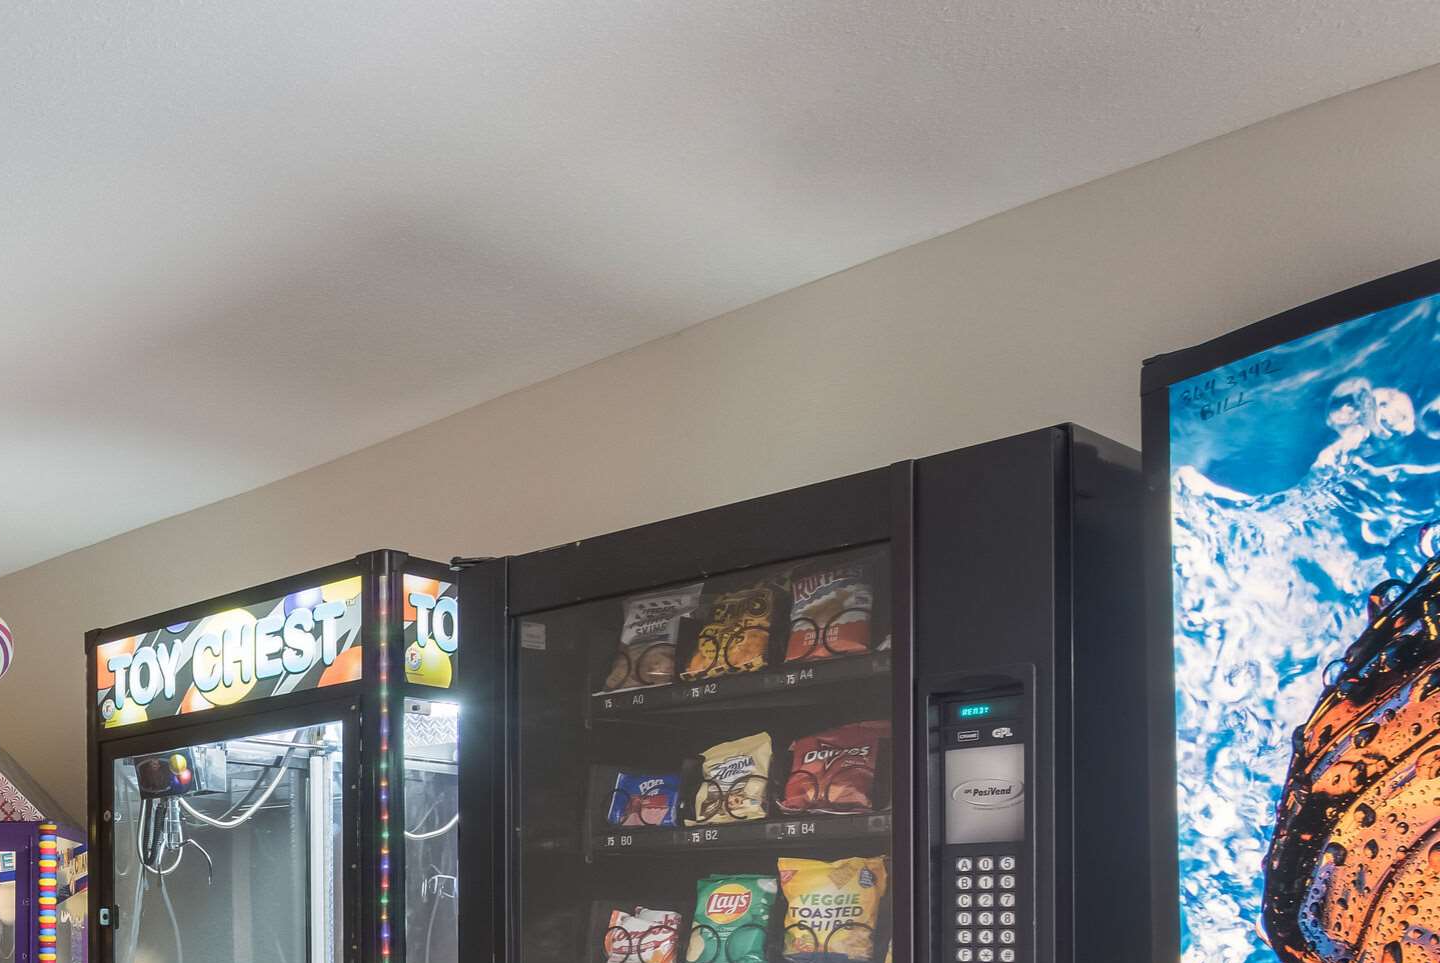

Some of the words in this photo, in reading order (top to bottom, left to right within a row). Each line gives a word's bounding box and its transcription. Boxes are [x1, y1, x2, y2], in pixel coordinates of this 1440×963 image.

[108, 639, 182, 710] TOY
[192, 601, 347, 693] CHEST
[800, 668, 814, 680] A4
[704, 683, 717, 694] A2
[632, 694, 644, 704] A0
[801, 823, 815, 834] B4
[705, 829, 718, 840] B2
[620, 835, 632, 846] B0
[800, 893, 861, 906] VEGGIE
[789, 905, 864, 919] TOASTED
